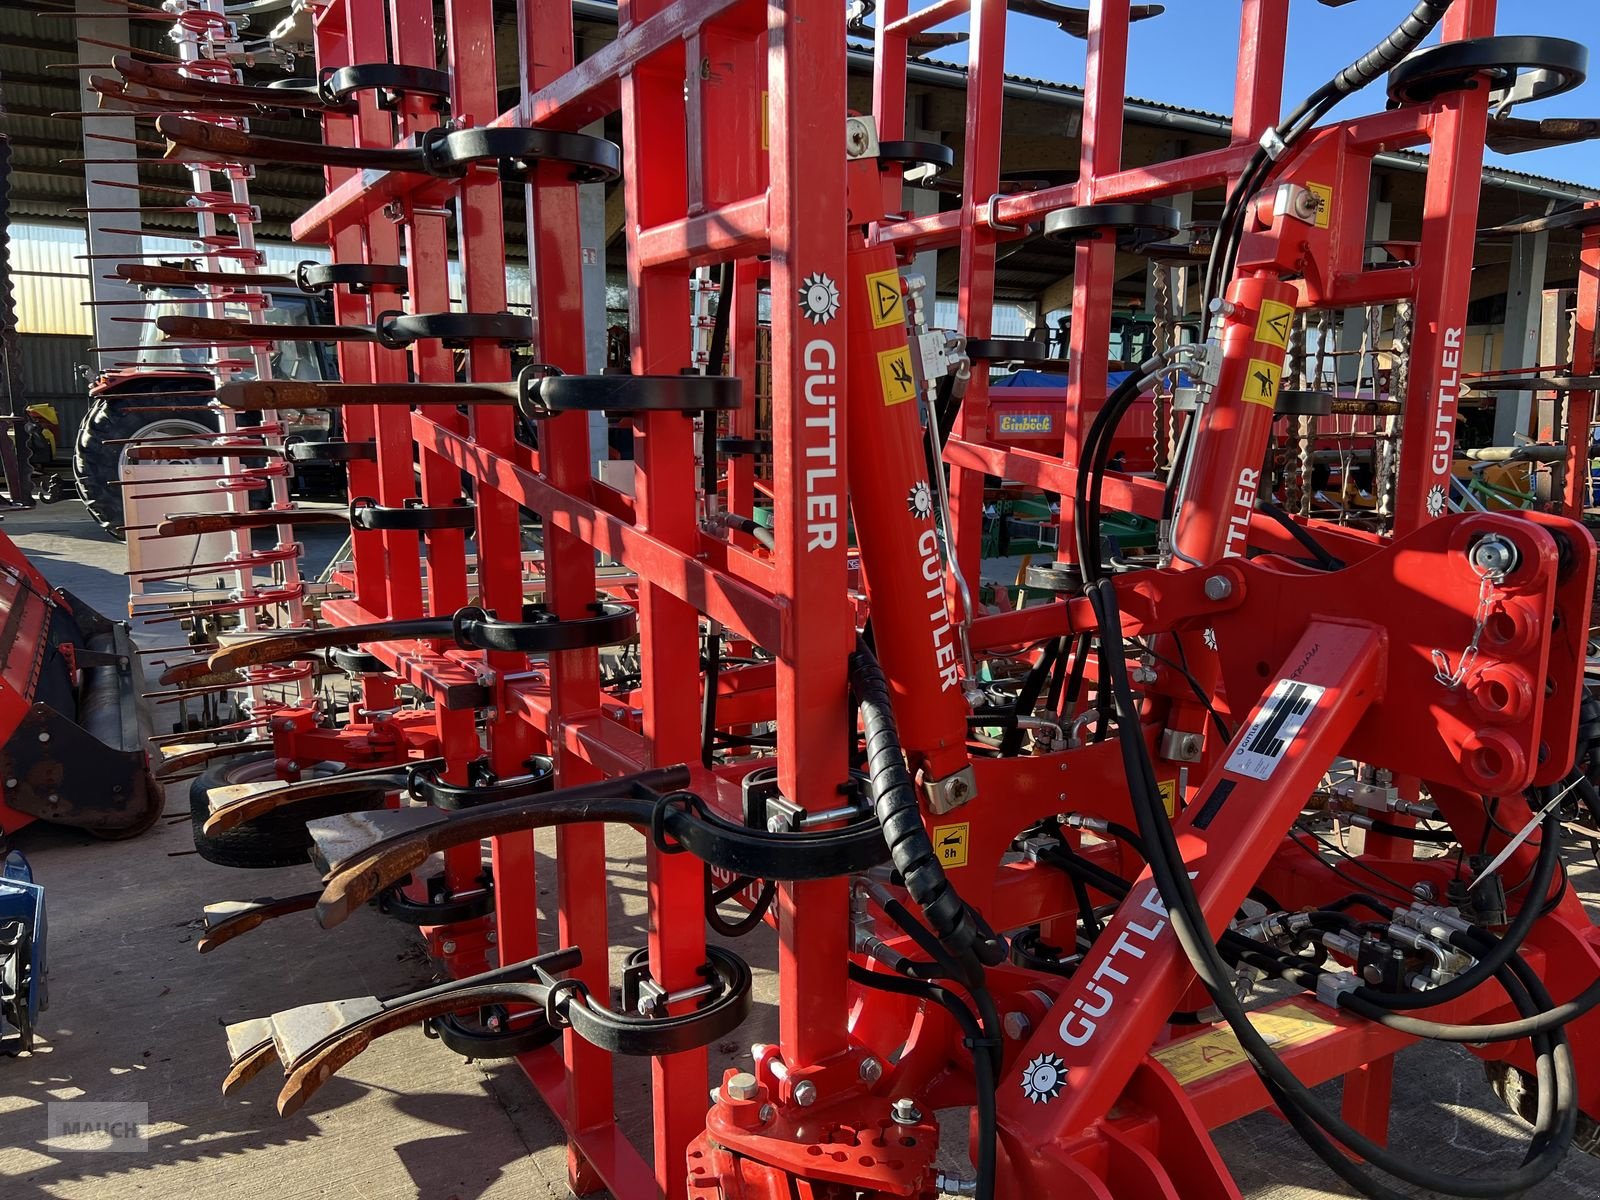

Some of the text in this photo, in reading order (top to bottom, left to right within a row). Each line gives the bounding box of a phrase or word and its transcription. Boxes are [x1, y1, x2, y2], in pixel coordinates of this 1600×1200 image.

[804, 339, 838, 553] GÜTTLER
[1001, 416, 1050, 430] Einböck
[1432, 327, 1462, 475] GÜTTLER
[1223, 467, 1260, 558] TTLER
[918, 529, 958, 693] GÜTTLER
[944, 848, 957, 858] 8h
[1059, 871, 1199, 1047] GÜTTLE
